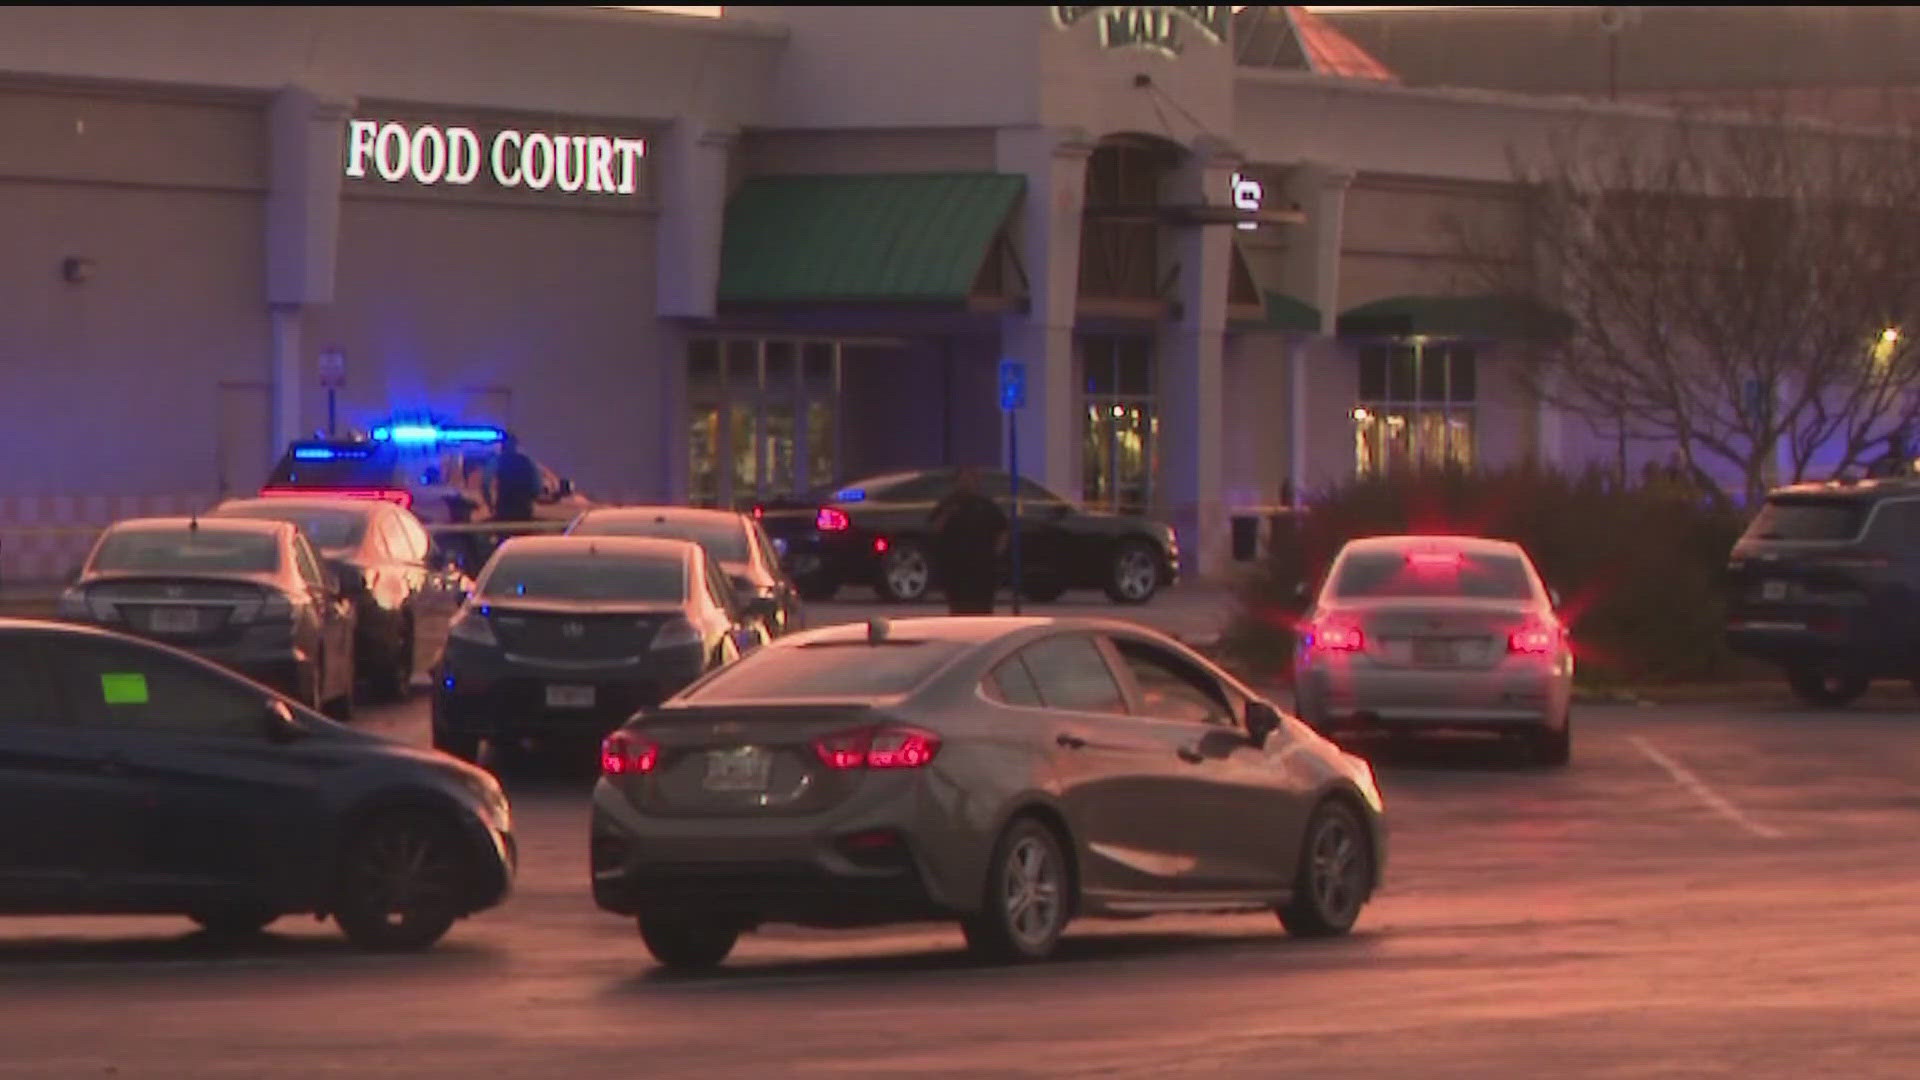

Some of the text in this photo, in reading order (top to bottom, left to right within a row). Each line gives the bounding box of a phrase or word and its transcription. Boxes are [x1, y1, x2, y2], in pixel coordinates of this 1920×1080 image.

[1098, 9, 1178, 54] MALL
[346, 120, 645, 195] FOOD COURT
